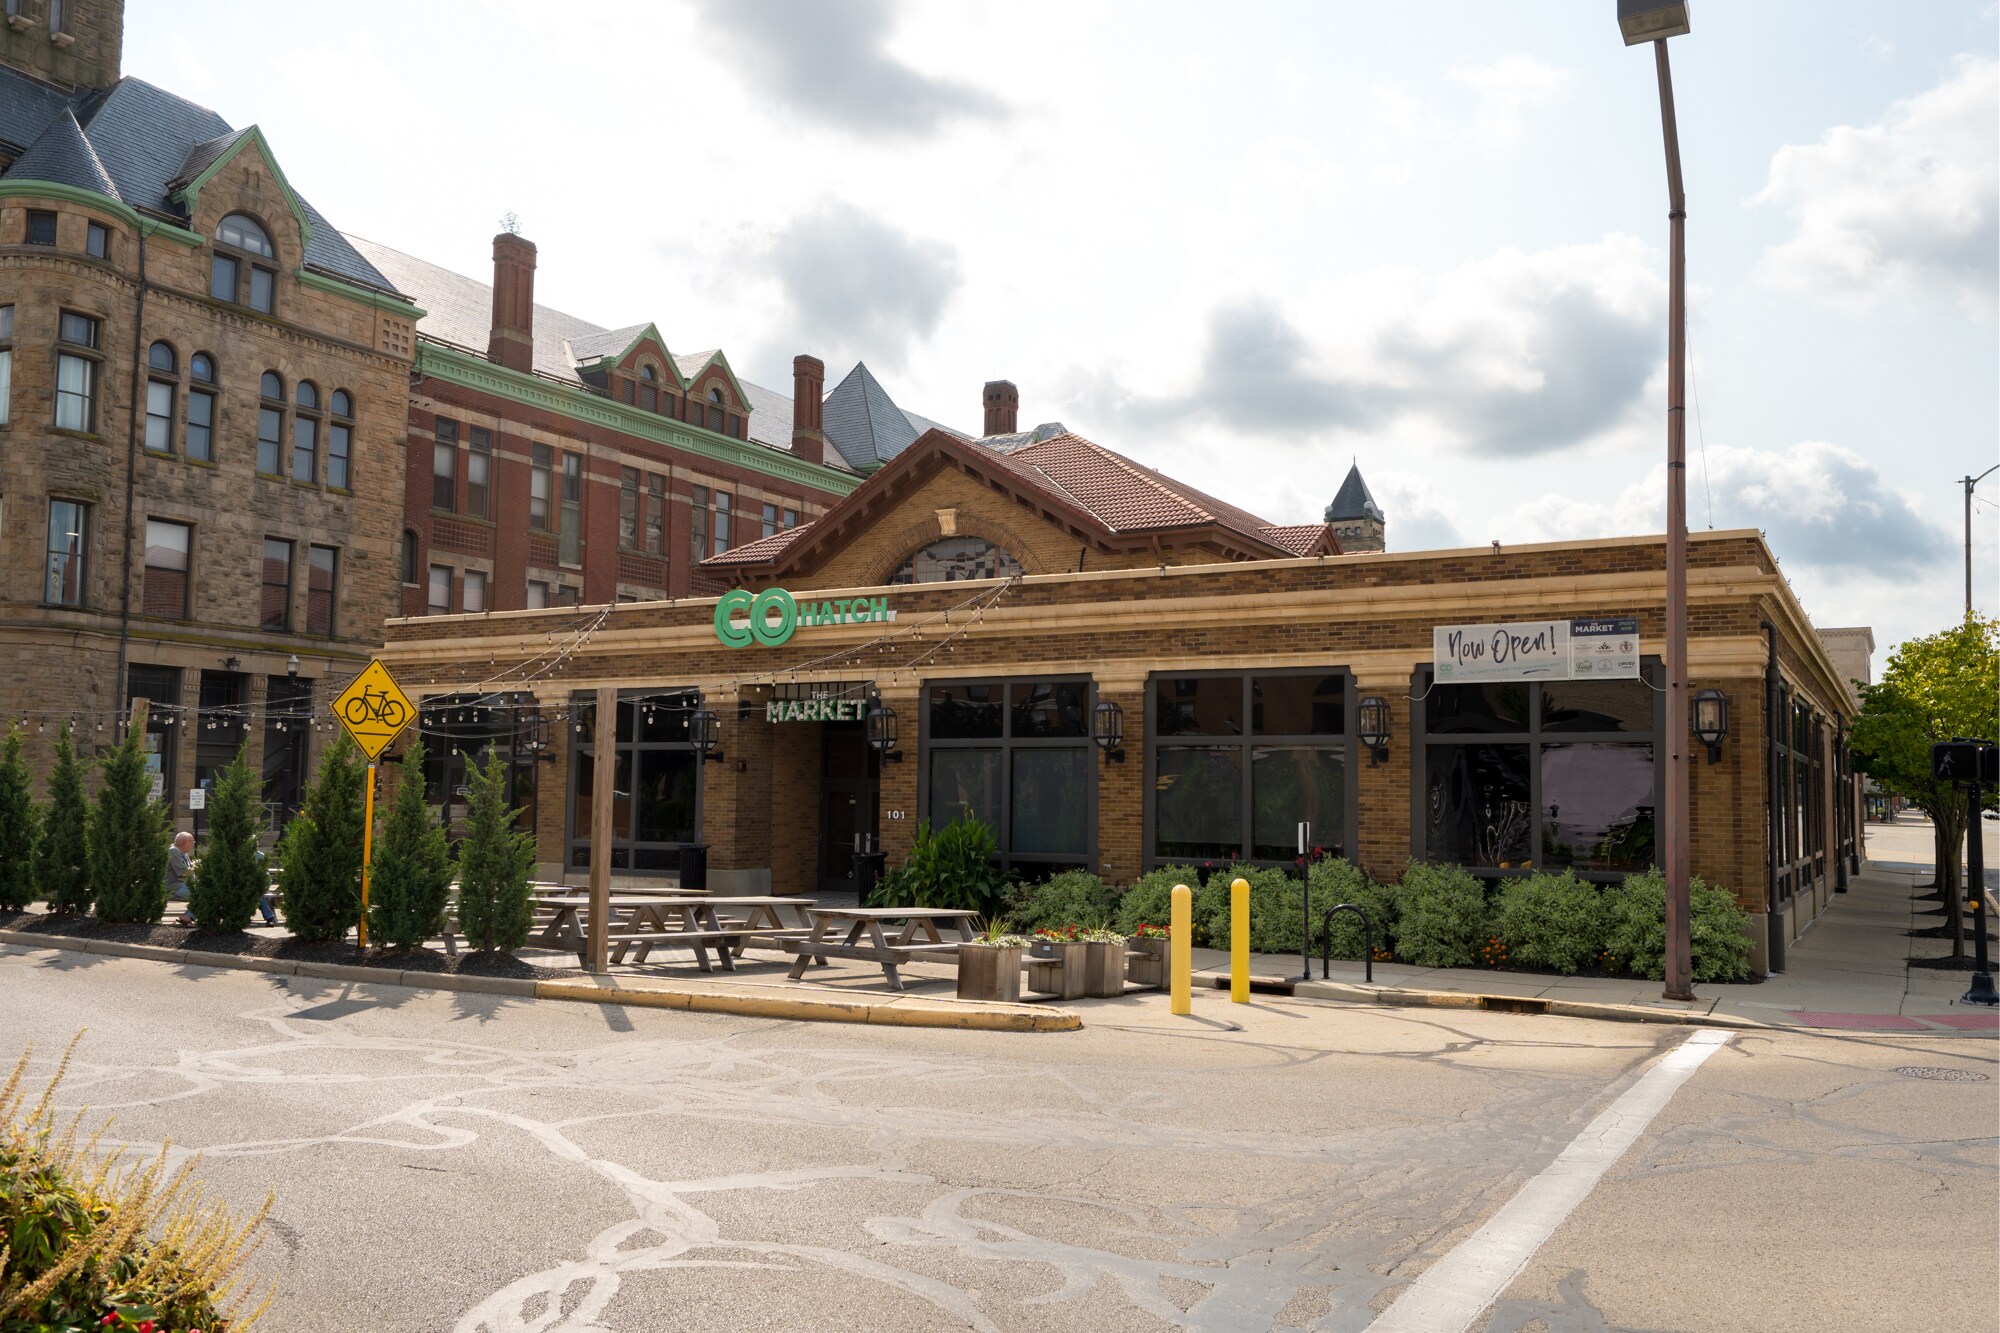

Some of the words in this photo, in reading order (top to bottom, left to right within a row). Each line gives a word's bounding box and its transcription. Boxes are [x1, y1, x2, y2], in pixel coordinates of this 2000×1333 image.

[1575, 624, 1614, 633] MARKET
[1448, 630, 1485, 666] Now
[1491, 626, 1557, 663] Open!
[811, 690, 829, 700] THE
[766, 699, 868, 722] MARKET
[887, 810, 905, 820] 101
